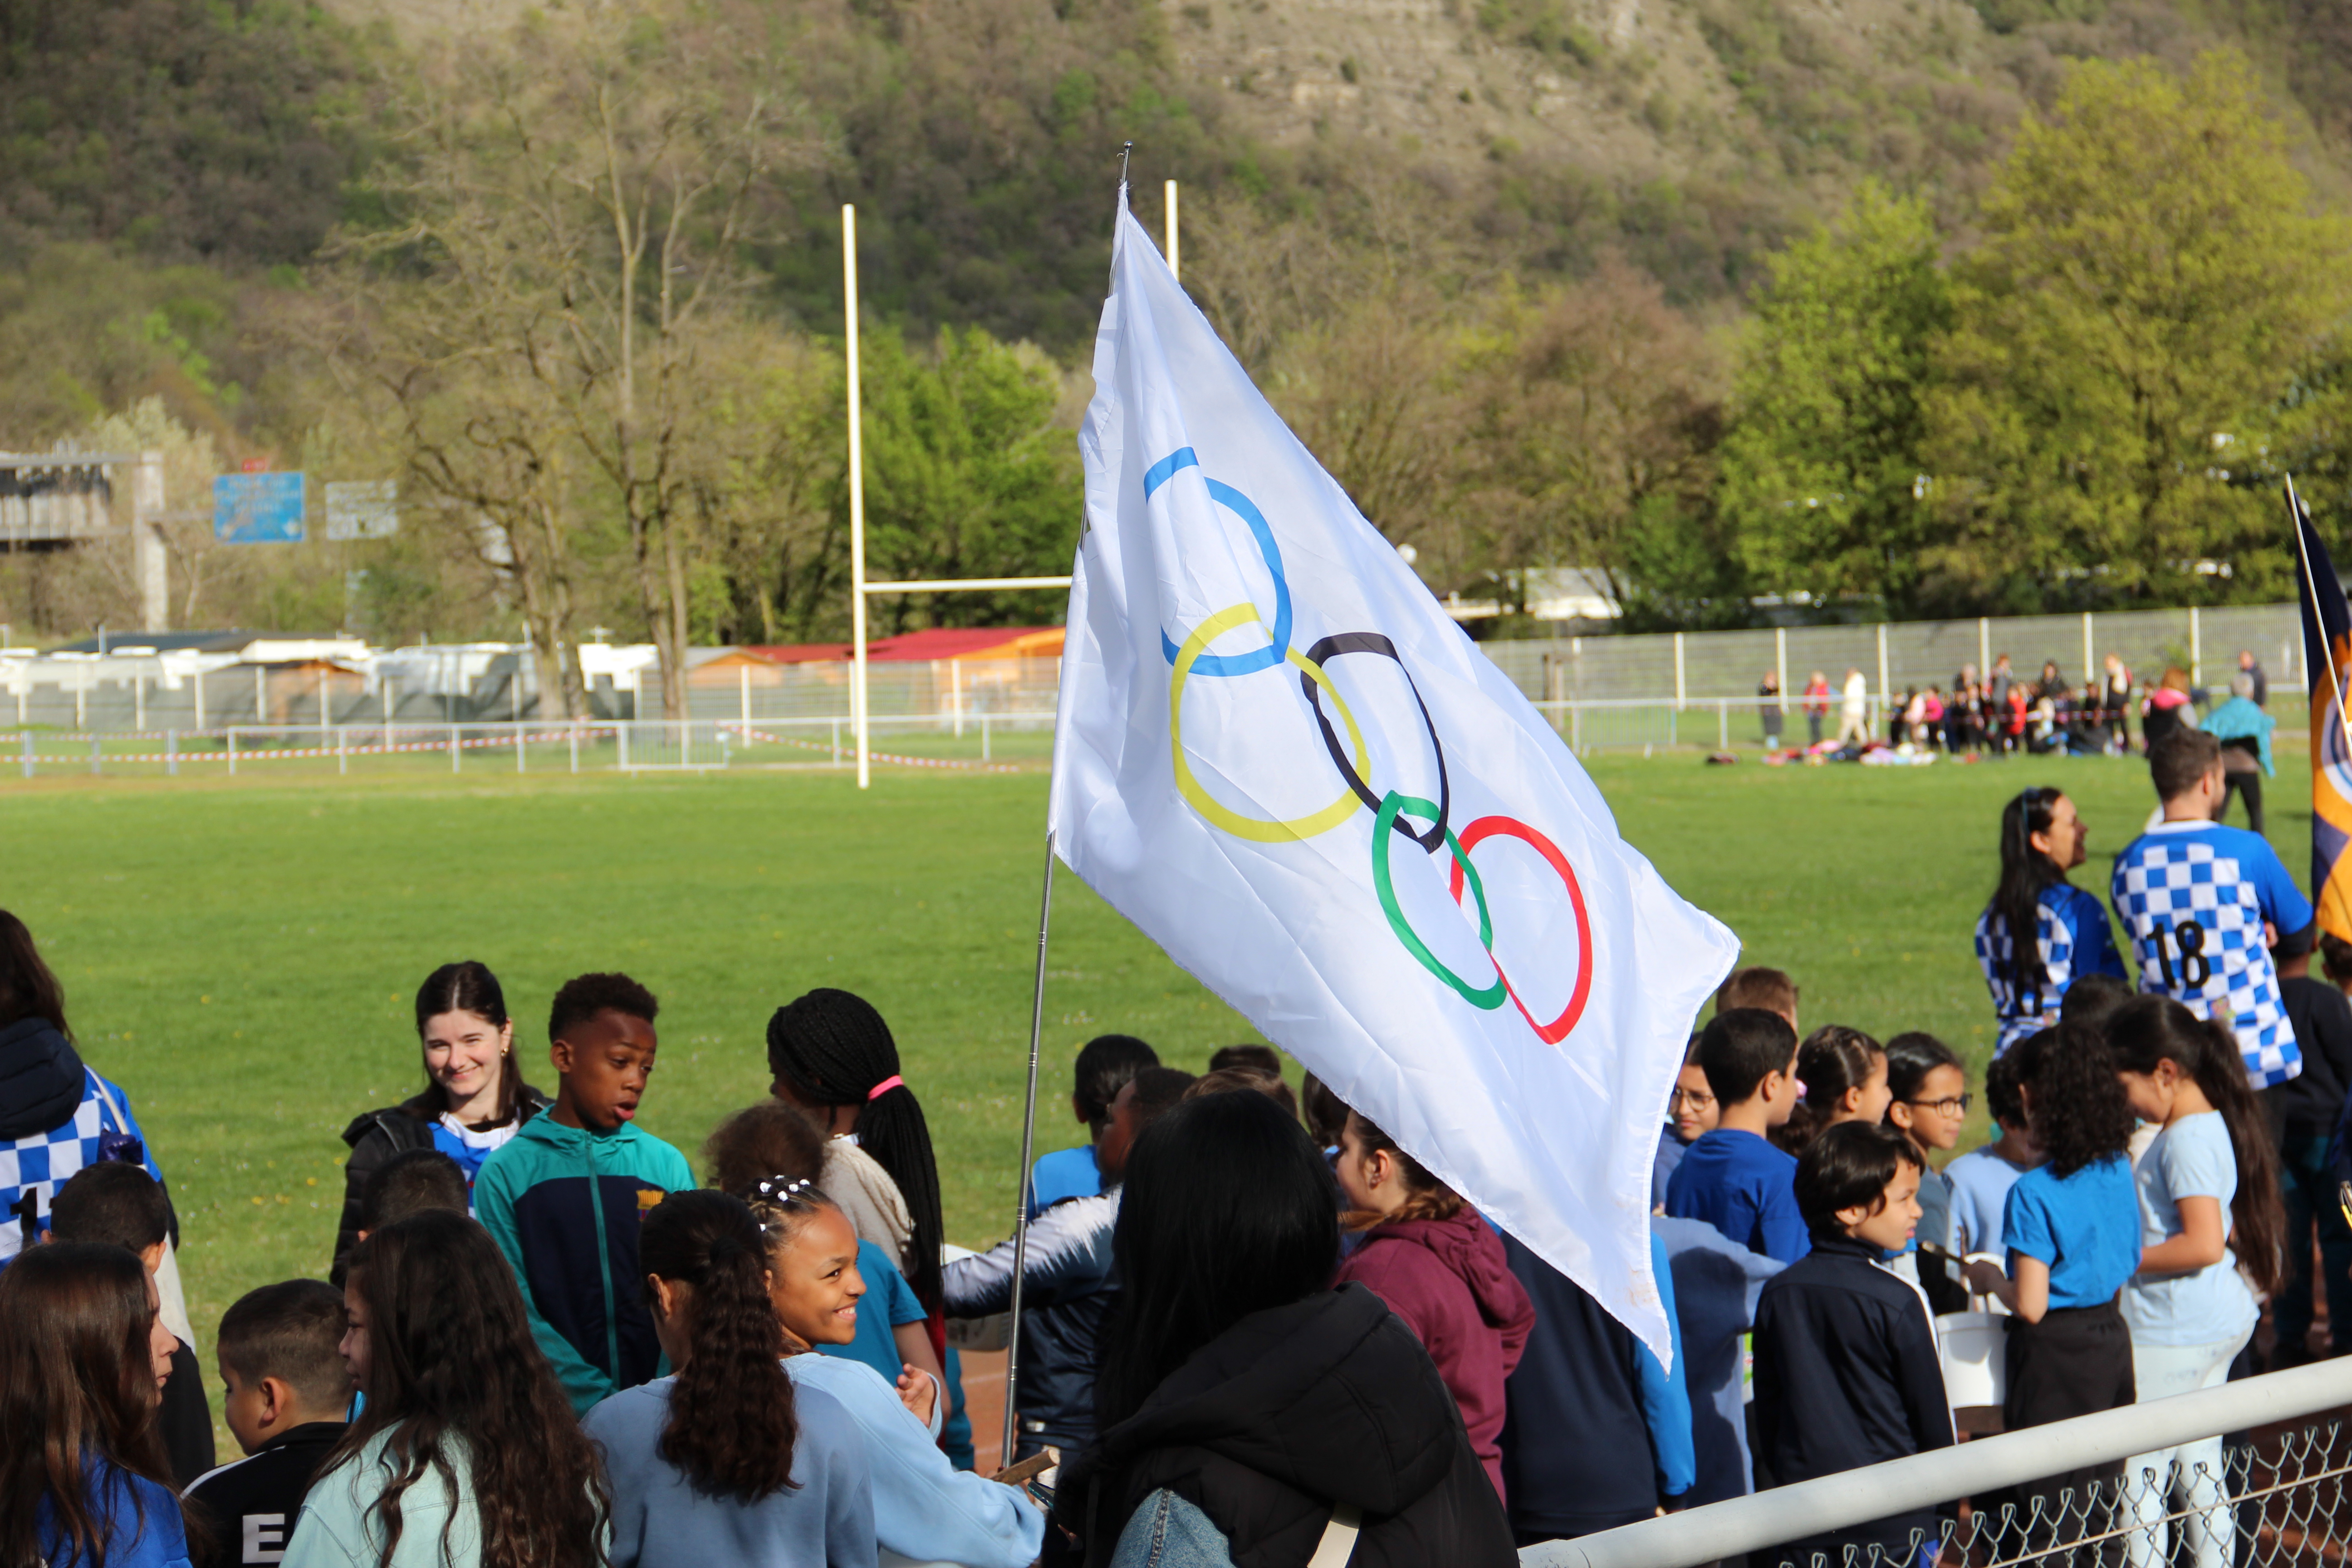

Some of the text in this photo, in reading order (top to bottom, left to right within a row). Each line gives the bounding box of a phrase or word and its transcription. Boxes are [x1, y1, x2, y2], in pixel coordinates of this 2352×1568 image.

[2146, 921, 2210, 990] 18
[10, 1187, 54, 1248] 1
[242, 1514, 285, 1563] E
